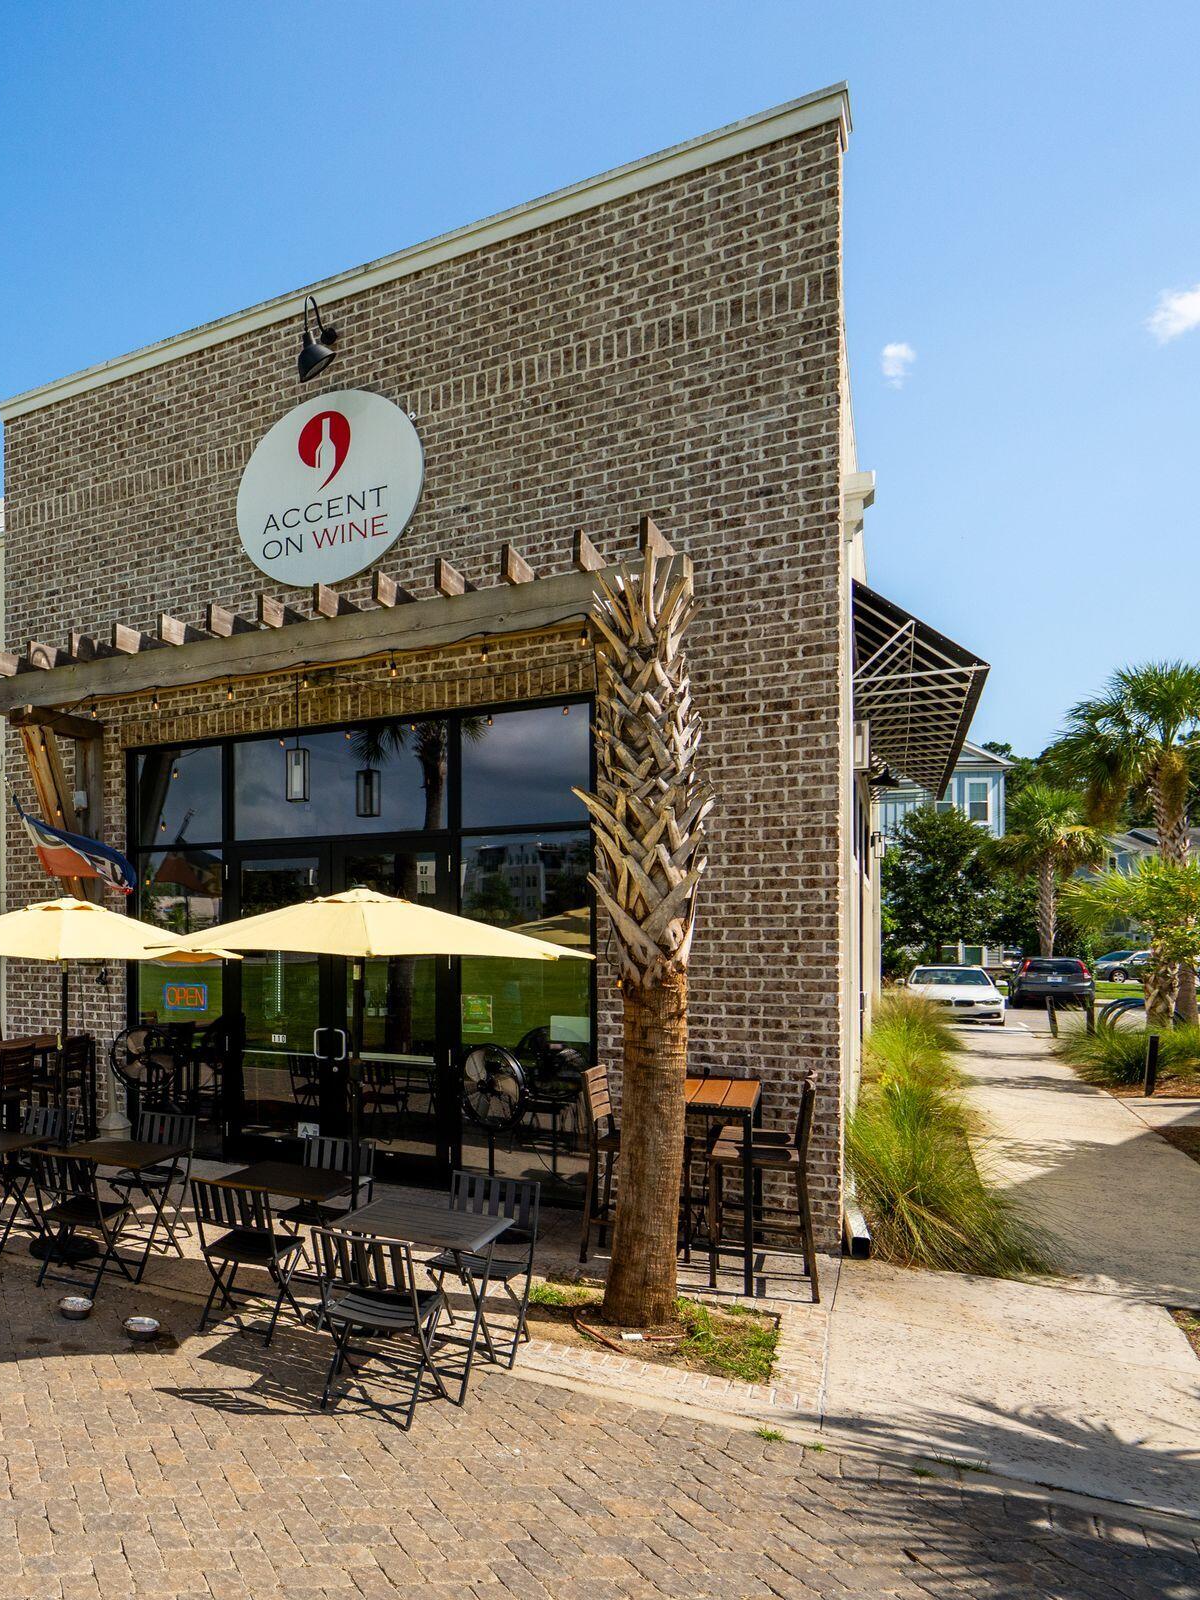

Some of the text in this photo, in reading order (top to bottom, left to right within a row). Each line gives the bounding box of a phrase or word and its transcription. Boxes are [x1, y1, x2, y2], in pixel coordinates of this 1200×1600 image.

[262, 485, 388, 535] ACCENT
[262, 514, 388, 560] ON WINE
[166, 986, 205, 1007] OPEN
[273, 1035, 286, 1043] 110
